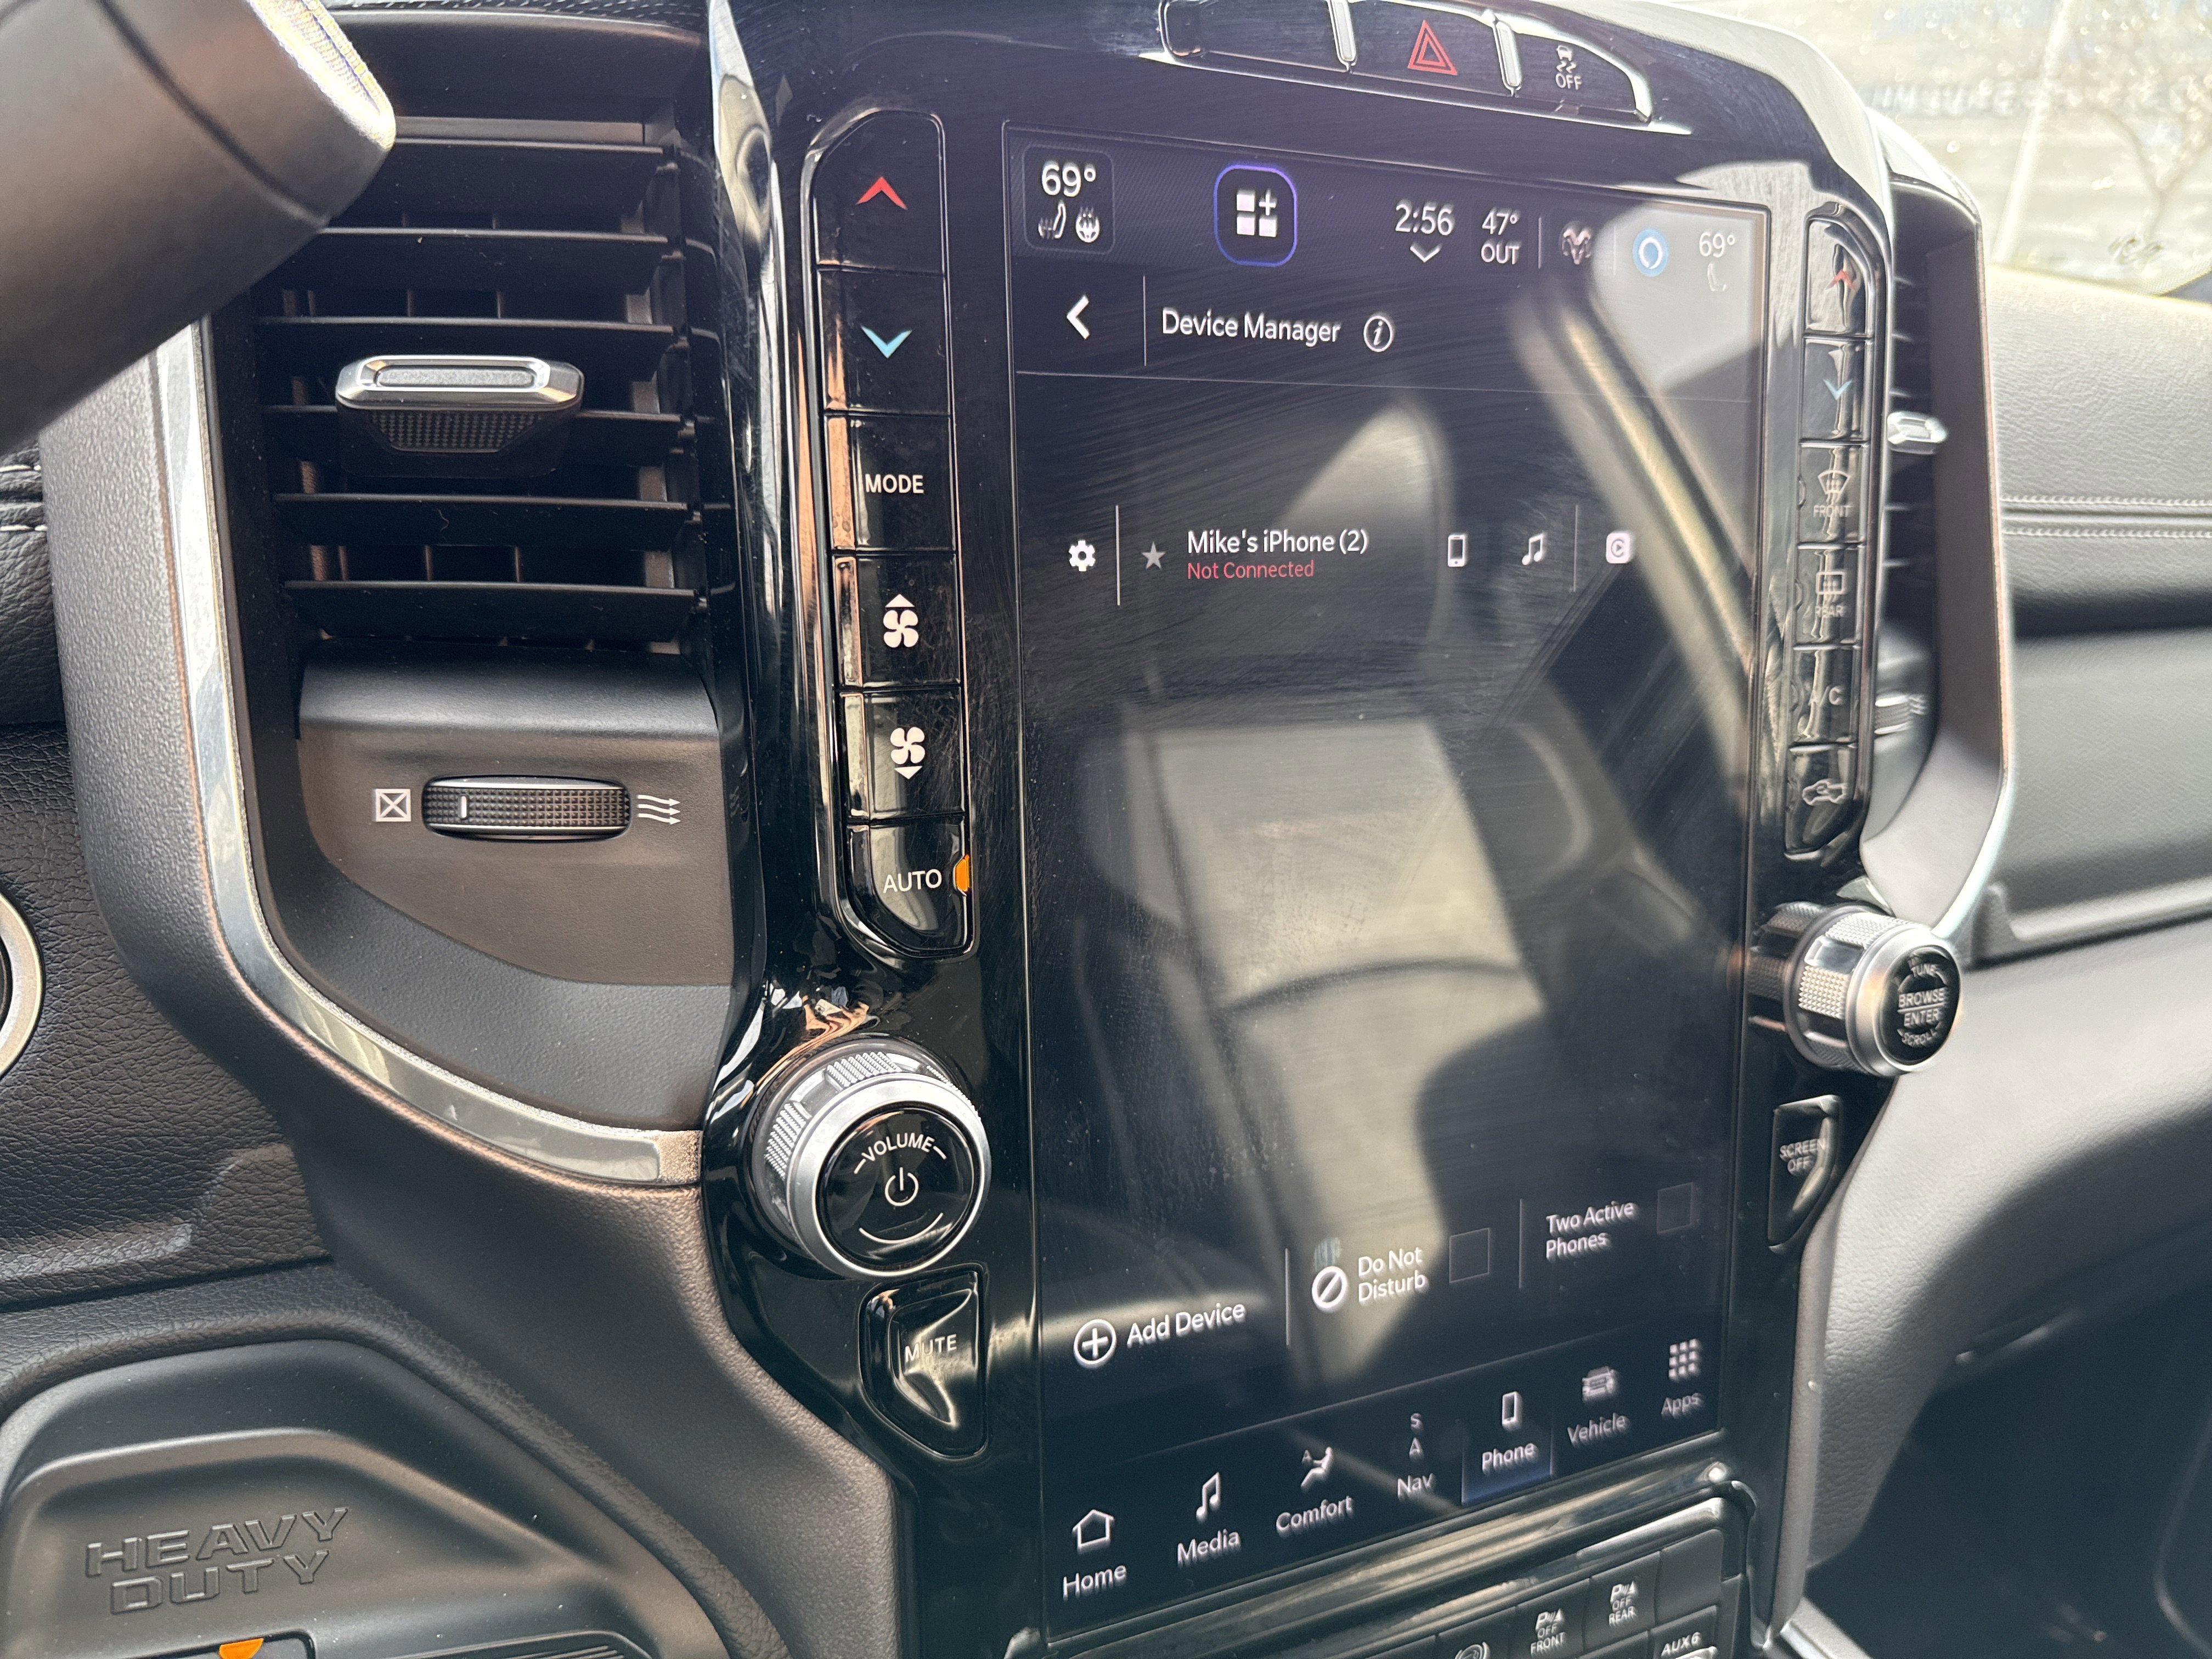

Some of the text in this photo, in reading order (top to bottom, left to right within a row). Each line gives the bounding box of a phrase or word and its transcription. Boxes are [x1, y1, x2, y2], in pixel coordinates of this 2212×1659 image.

[1556, 73, 1582, 90] OFF
[1041, 161, 1097, 197] 69°
[1395, 200, 1454, 235] 2:56
[1482, 207, 1519, 235] 47°
[1481, 242, 1520, 264] OUT
[1699, 232, 1736, 257] 69°
[1163, 308, 1341, 347] Device Manager
[865, 474, 924, 494] MODE
[1813, 505, 1851, 517] FRONT
[1188, 529, 1368, 554] Mike's iPhone (2)
[1188, 560, 1314, 579] Not Connected
[883, 869, 942, 894] AUTO
[1911, 963, 1937, 977] TUNE
[1899, 987, 1945, 1008] BROWSE
[1904, 1008, 1939, 1027] ENTER
[1901, 1029, 1937, 1046] SCROLL
[862, 1132, 935, 1163] VOLUME
[1779, 1138, 1826, 1160] SCREEN
[1787, 1156, 1812, 1174] OFF
[1547, 1201, 1637, 1235] Two Active
[1546, 1232, 1611, 1261] Phones
[1358, 1247, 1423, 1277] Do Not
[1358, 1270, 1427, 1302] Disturb
[1127, 1302, 1245, 1347] Add Device
[905, 1334, 958, 1363] MUTE
[1661, 1392, 1702, 1419] Apps
[1567, 1413, 1629, 1447] Vehicle
[1482, 1443, 1537, 1475] Phone
[1397, 1473, 1435, 1500] Nav
[1276, 1496, 1353, 1535] Comfort
[85, 1507, 349, 1577] HEAVY
[1177, 1529, 1241, 1567] Media
[111, 1550, 329, 1615] DUTY
[1063, 1565, 1126, 1600] Home
[1609, 1606, 1637, 1627] REAR
[1612, 1596, 1632, 1612] OFF
[1531, 1633, 1566, 1655] FRONT
[1538, 1624, 1557, 1639] OFF
